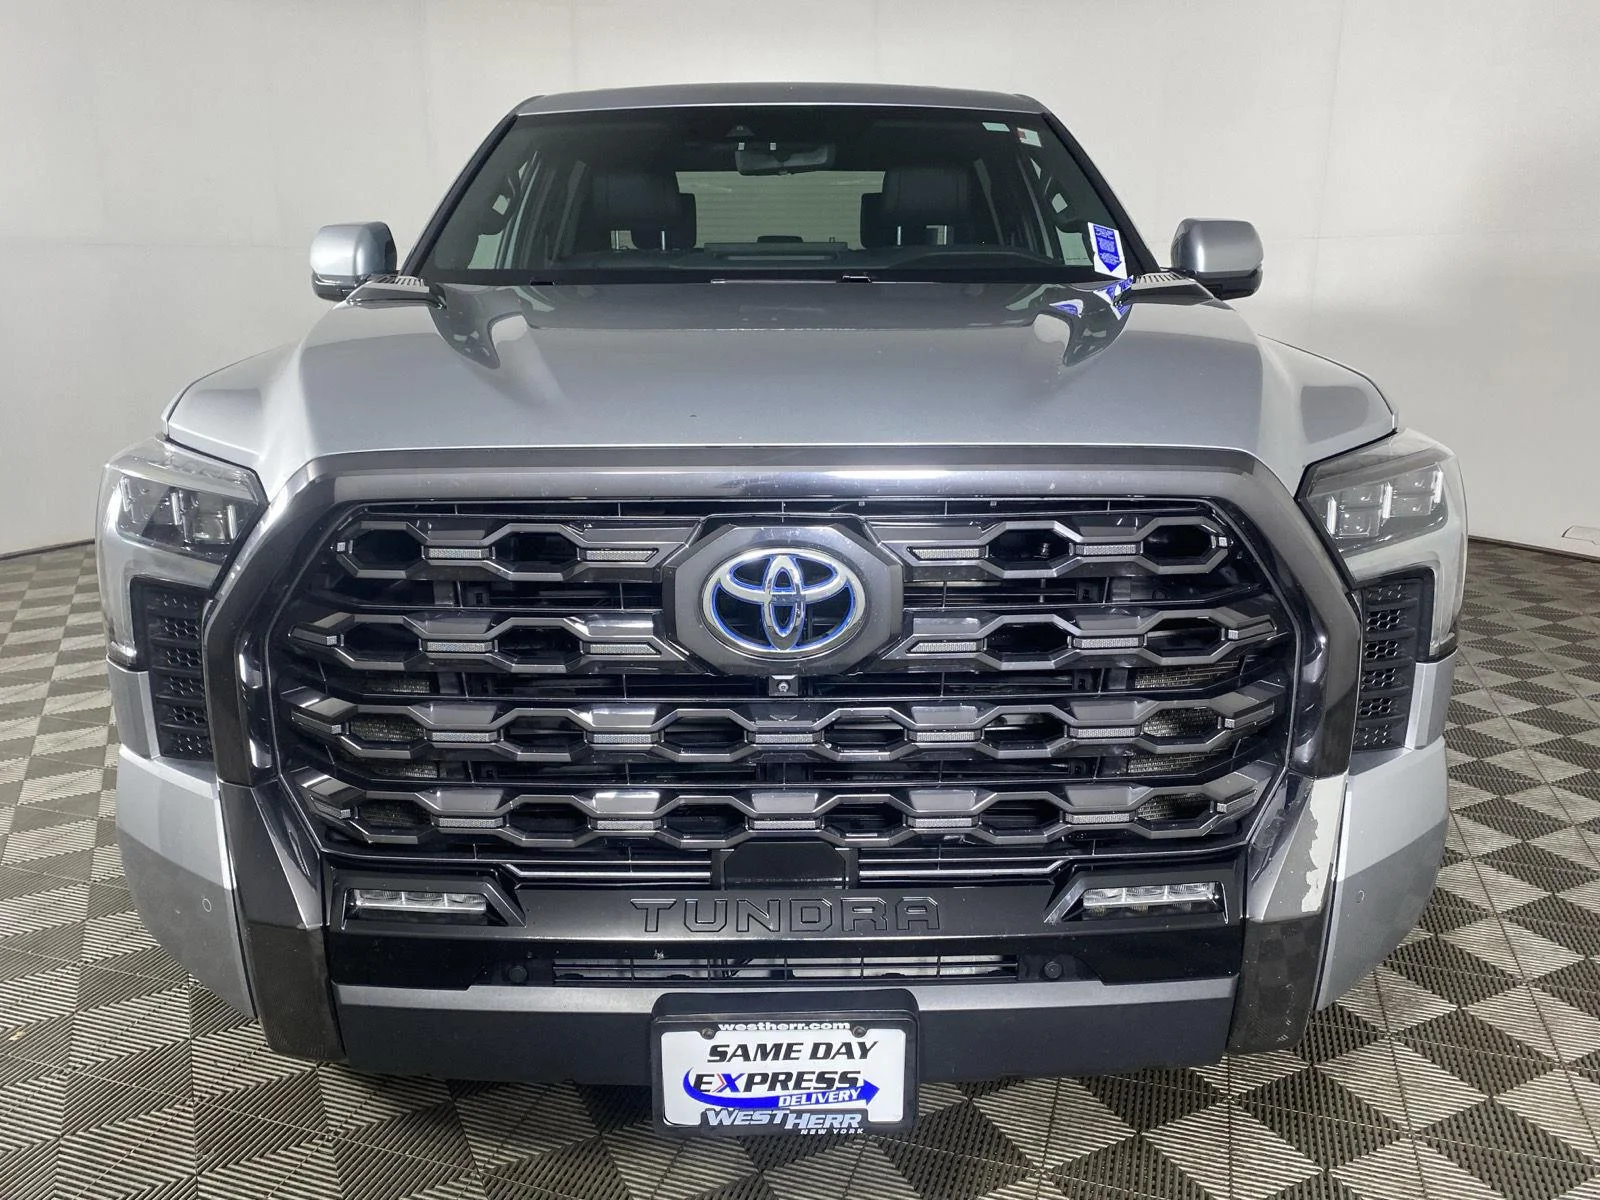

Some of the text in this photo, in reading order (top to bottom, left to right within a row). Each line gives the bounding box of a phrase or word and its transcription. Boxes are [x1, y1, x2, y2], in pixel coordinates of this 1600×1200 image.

[630, 896, 940, 932] TUNDRA
[717, 1021, 850, 1031] westherr.com
[707, 1040, 879, 1063] SAME DAY
[692, 1070, 861, 1093] EXPRESS
[778, 1088, 861, 1108] DELIVERY
